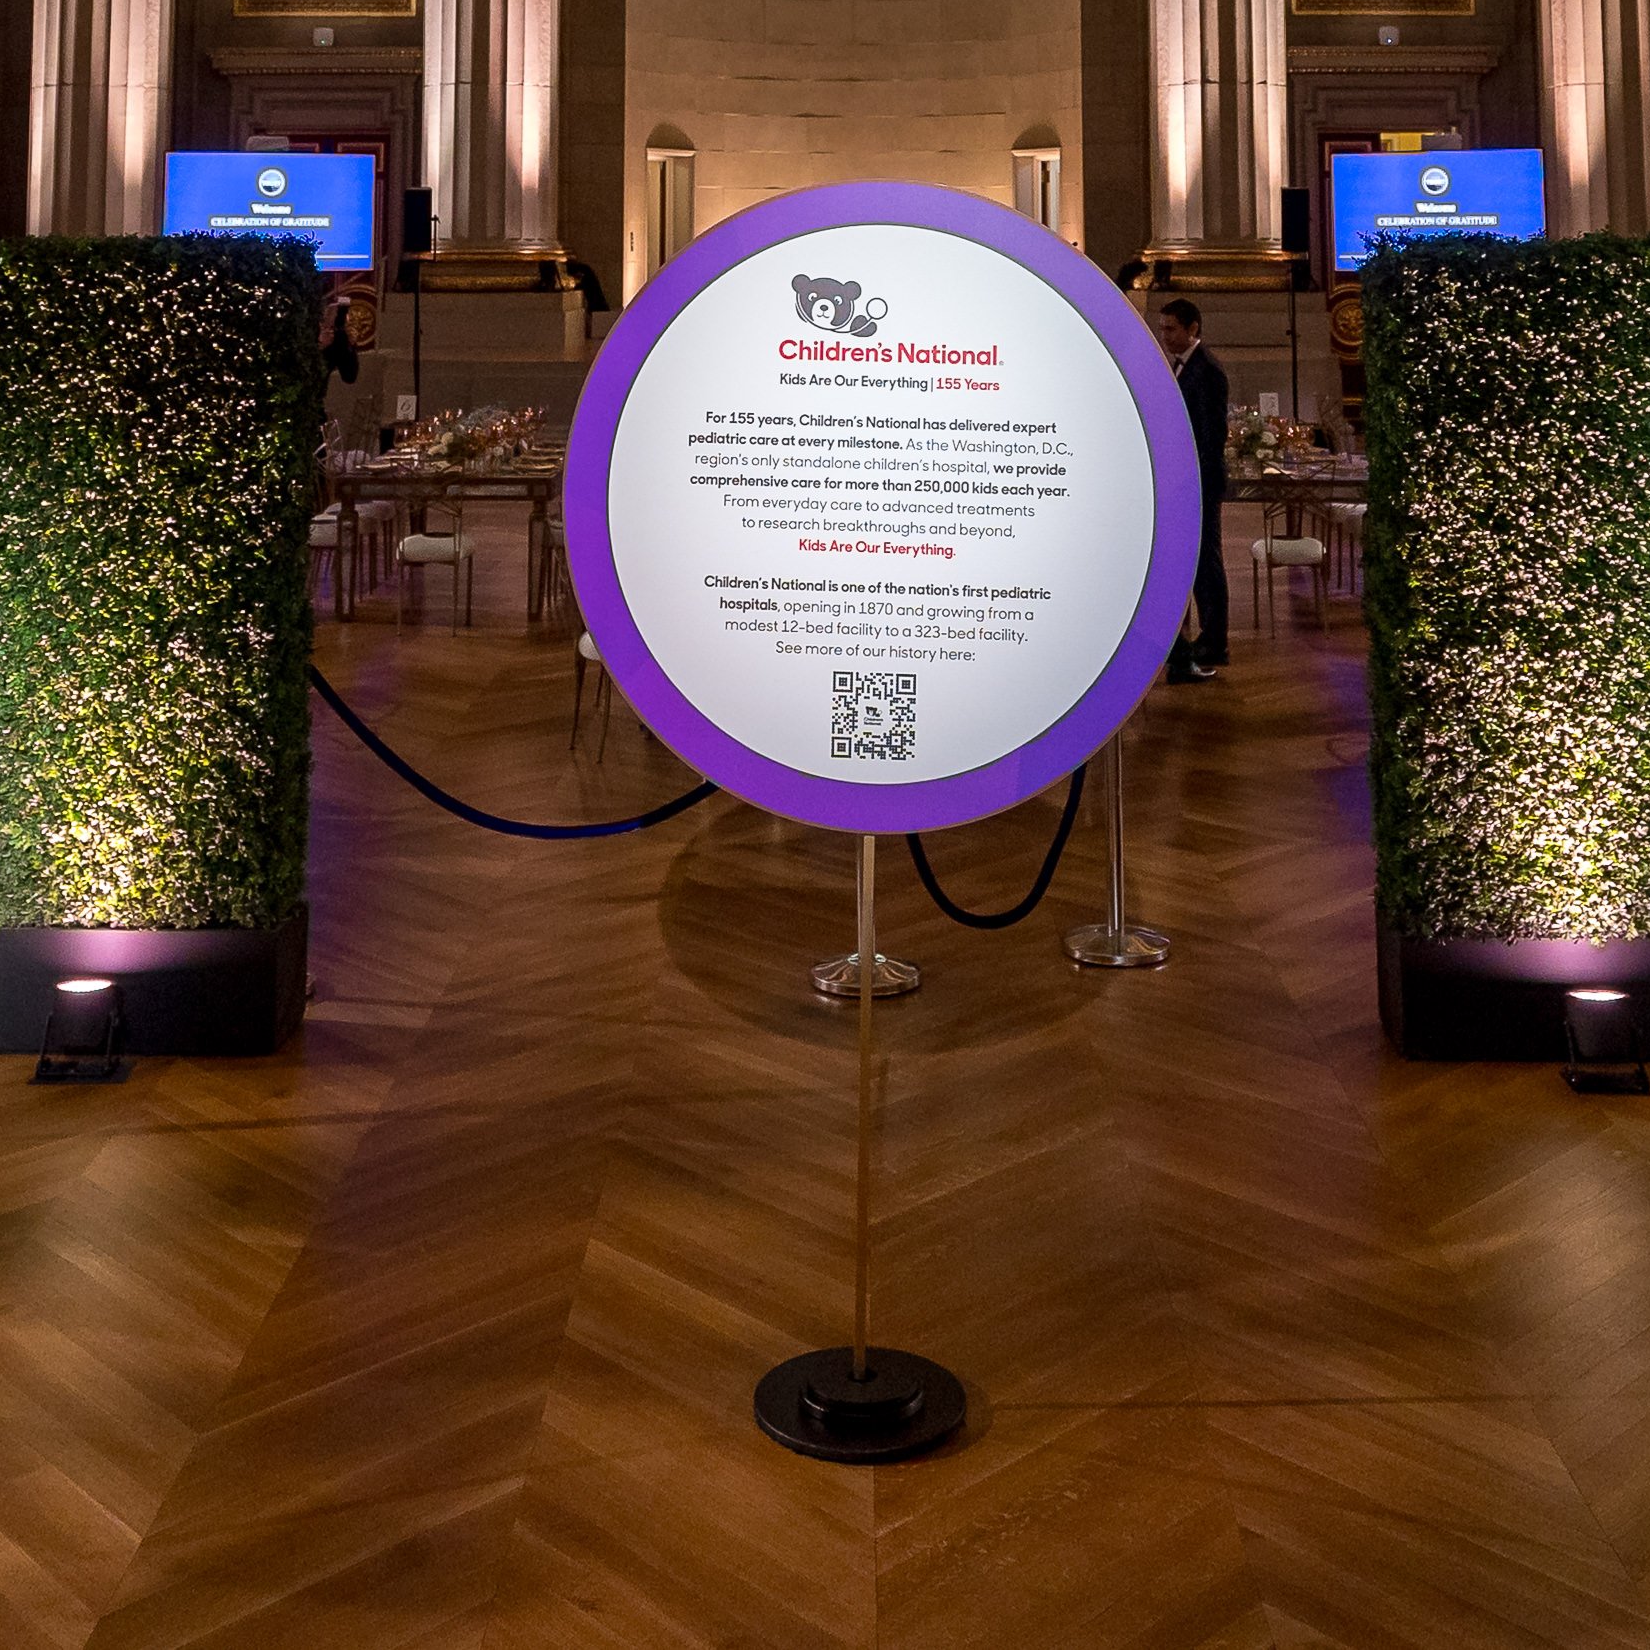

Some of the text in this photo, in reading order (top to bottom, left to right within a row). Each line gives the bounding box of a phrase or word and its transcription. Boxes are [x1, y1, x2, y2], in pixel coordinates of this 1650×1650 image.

[269, 218, 282, 226] OF
[282, 217, 330, 227] GRATITUDE
[1435, 216, 1448, 226] OF
[1448, 215, 1498, 226] GRATITUDE
[778, 339, 893, 362] Children's
[780, 373, 806, 386] Kids
[809, 374, 832, 386] Are
[834, 374, 859, 387] Our
[936, 378, 961, 390] 155
[964, 378, 1000, 391] Years
[706, 411, 1056, 436] For 155 years, Children's National has delivered expert
[688, 432, 1073, 457] pediatric care at every milestone. As the Washington, D.C.,
[695, 452, 1066, 478] region's only standalone children's hospital, we provide
[690, 474, 1070, 500] comprehensive care for more than 250,000 kids each year.
[724, 494, 1035, 517] From everyday care to advanced treatments
[742, 517, 1016, 540] to research breakthroughs and beyond,
[799, 538, 956, 560] Kids Are Our Everything.
[704, 575, 1051, 601] Children's National is one of the nation's first pediatric
[720, 596, 1034, 622] hospitals, opening in 1870 and growing from a
[725, 619, 1028, 645] modest 12-bed facility to a 323-bed facility.
[776, 640, 975, 663] See more of our history here:
